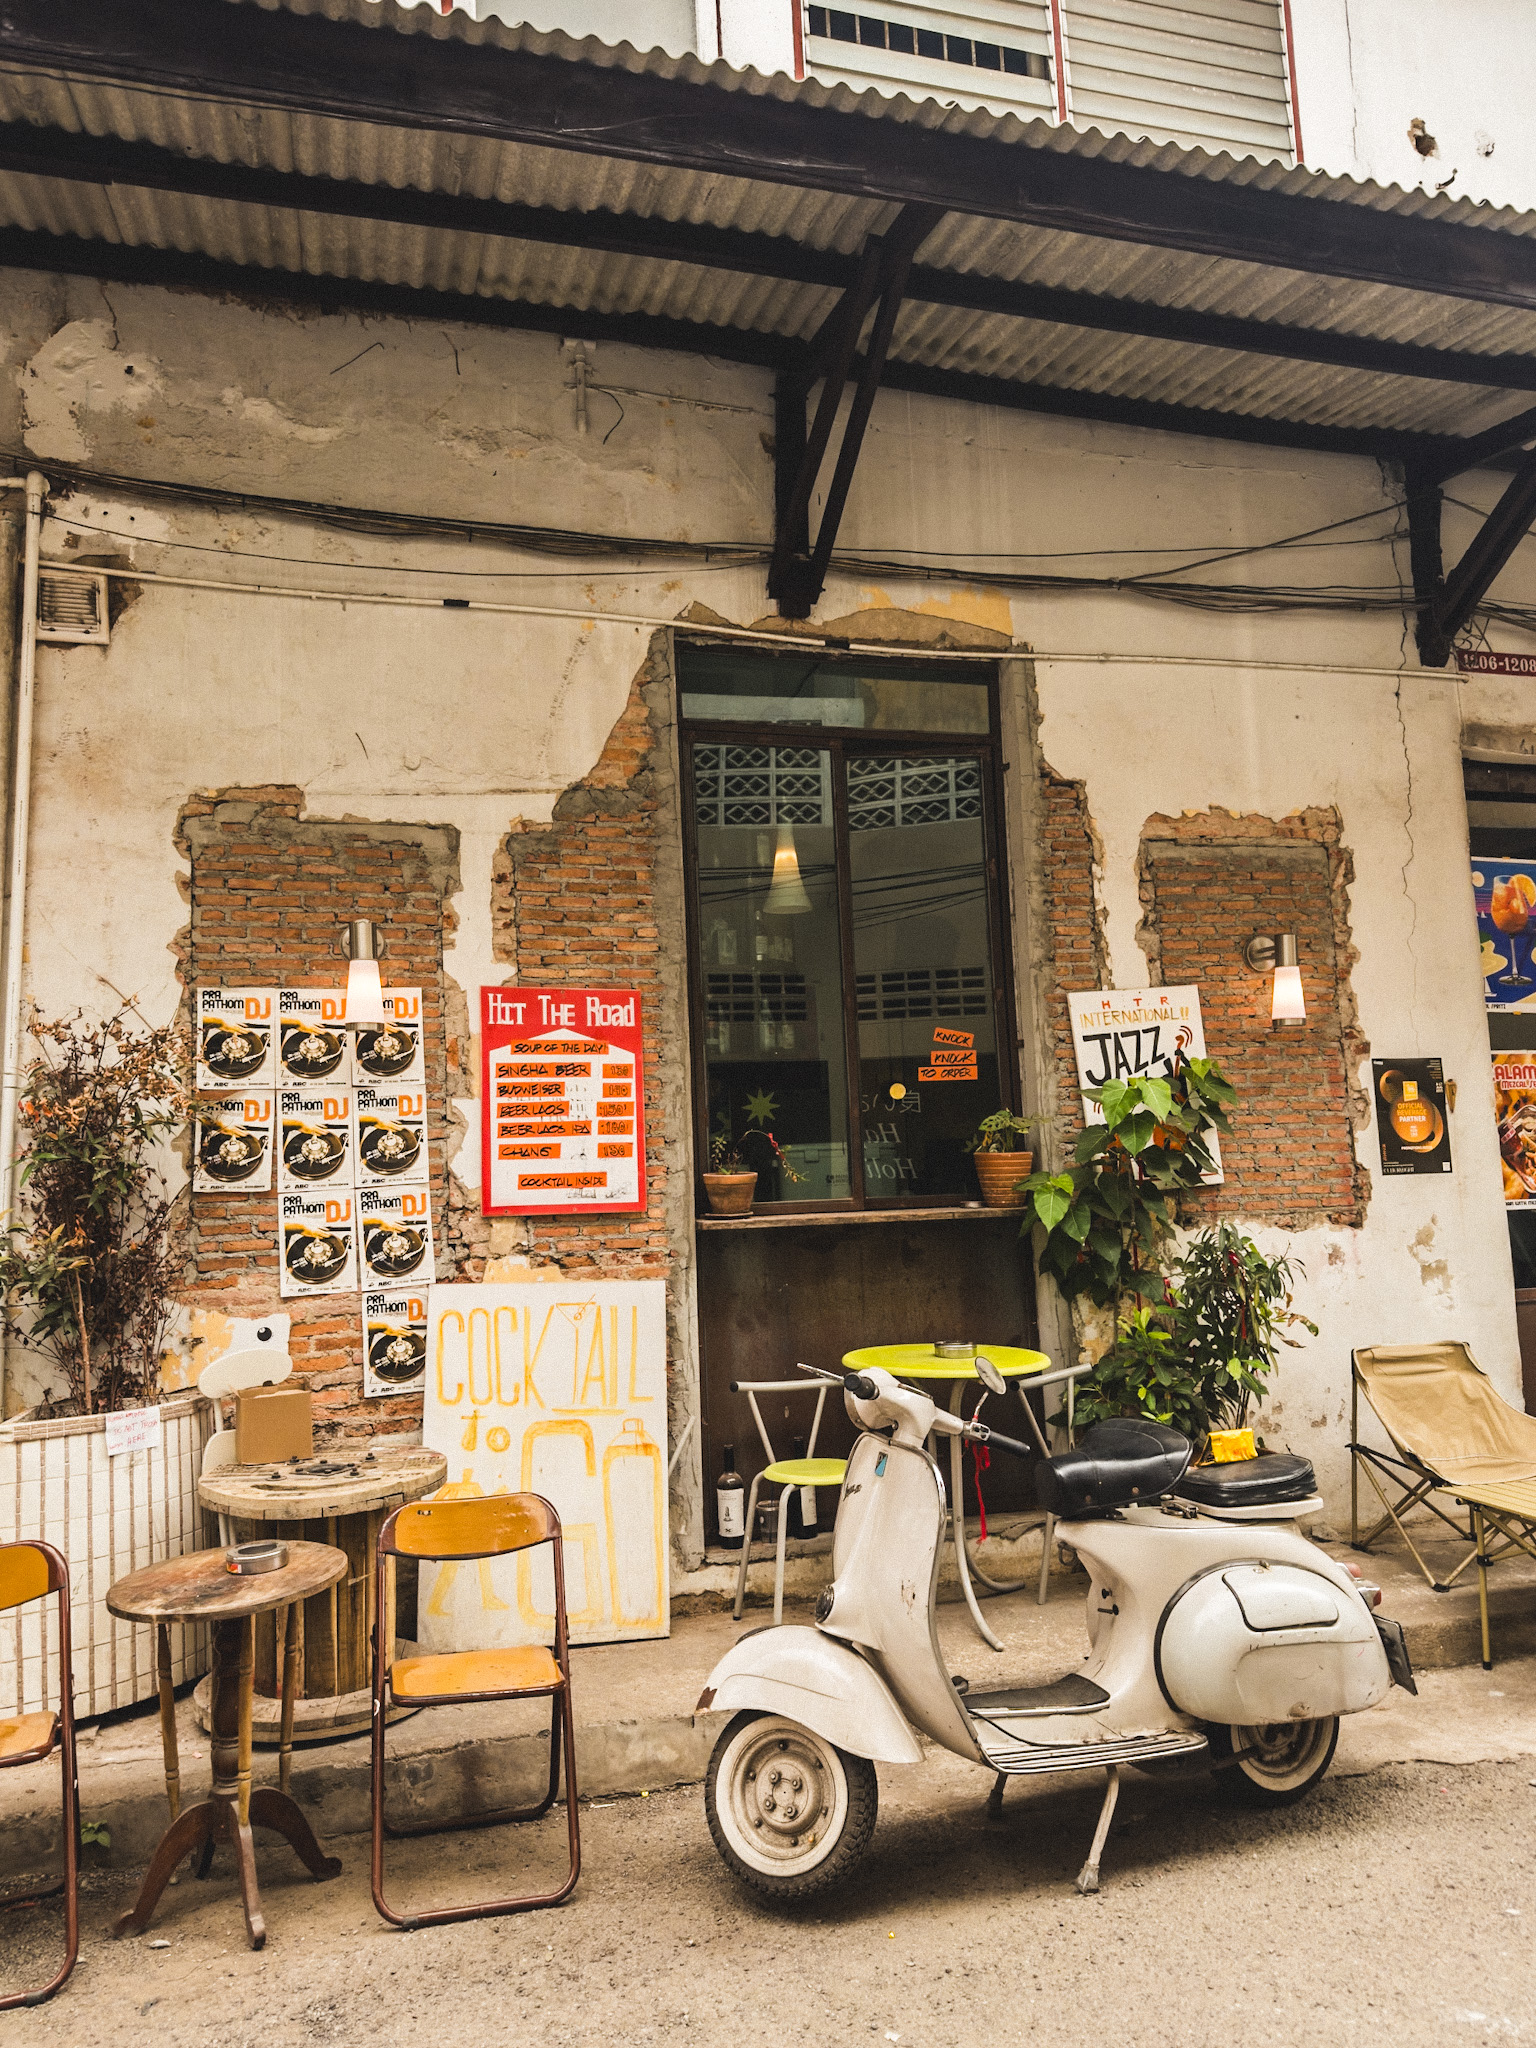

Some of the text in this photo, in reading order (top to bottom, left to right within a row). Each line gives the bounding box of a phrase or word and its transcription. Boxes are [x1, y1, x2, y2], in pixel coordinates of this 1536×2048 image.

[202, 990, 221, 999] PRA
[280, 991, 298, 1000] PRA
[202, 997, 271, 1020] PATHOM DJ
[280, 998, 347, 1020] PATHOM DJ
[394, 997, 419, 1019] DJ
[488, 993, 636, 1027] HIT THE Road
[935, 1031, 971, 1046] KNOCK
[514, 1043, 542, 1053] SOUP
[544, 1043, 558, 1051] OF
[561, 1043, 580, 1053] THE
[935, 1052, 973, 1064] KNOCK
[1082, 1025, 1165, 1087] JAZZ
[498, 1064, 548, 1078] SINGHA
[555, 1063, 590, 1077] BEER
[921, 1067, 971, 1078] TO ORDER
[1492, 1064, 1536, 1080] ALAM
[357, 1090, 376, 1099] PRA
[497, 1084, 563, 1096] BUDWEISER
[281, 1093, 300, 1102] PRA
[244, 1099, 271, 1122] DJ
[281, 1097, 349, 1121] PATHOM DJ
[357, 1094, 423, 1117] PATHOM DJ
[500, 1104, 530, 1117] BEER
[532, 1104, 565, 1115] LAOS
[1397, 1102, 1424, 1110] OFFICIAL
[501, 1125, 535, 1136] BEER
[537, 1124, 565, 1134] LAOS
[501, 1147, 552, 1157] CHANG
[520, 1176, 604, 1188] COCKTAIL INSIDE
[283, 1195, 302, 1206] PRA
[361, 1190, 379, 1200] PRA
[283, 1199, 351, 1223] PATHOM DJ
[361, 1193, 427, 1217] PATHOM DJ
[366, 1294, 385, 1304] PRA
[366, 1301, 407, 1314] PATHOM
[436, 1301, 654, 1409] COCKTAIL
